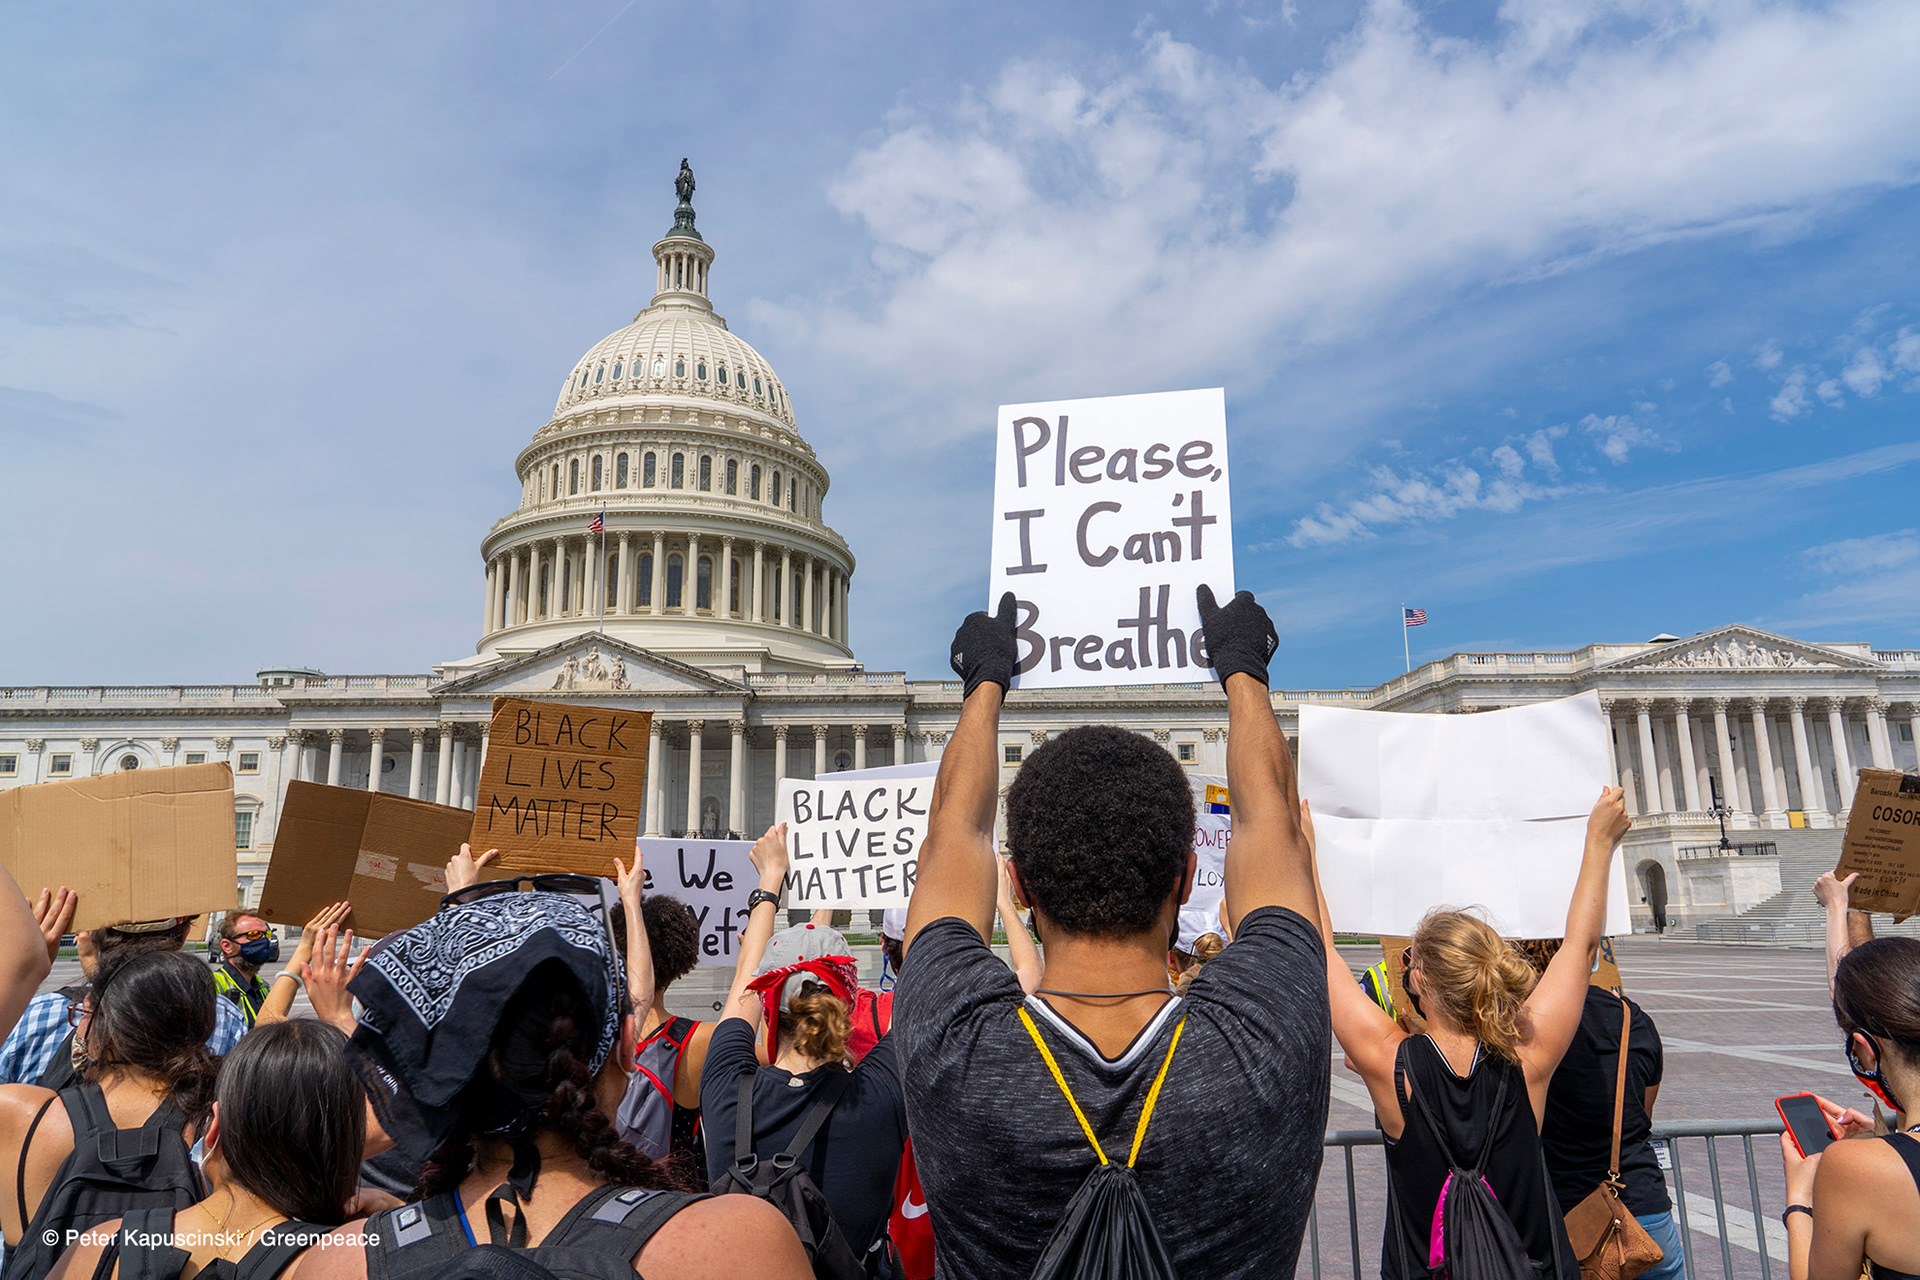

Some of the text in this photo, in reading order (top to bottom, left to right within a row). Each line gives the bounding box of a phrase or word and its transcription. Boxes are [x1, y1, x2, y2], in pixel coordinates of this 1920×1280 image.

[1013, 415, 1222, 488] Please,
[1004, 490, 1217, 576] I Can't
[515, 709, 628, 750] BLACK
[505, 754, 615, 791] LIVES
[488, 794, 619, 842] MATTER
[793, 787, 926, 824] BLACK
[794, 826, 915, 860] LIVES
[678, 848, 733, 891] We
[779, 859, 918, 901] MATTER
